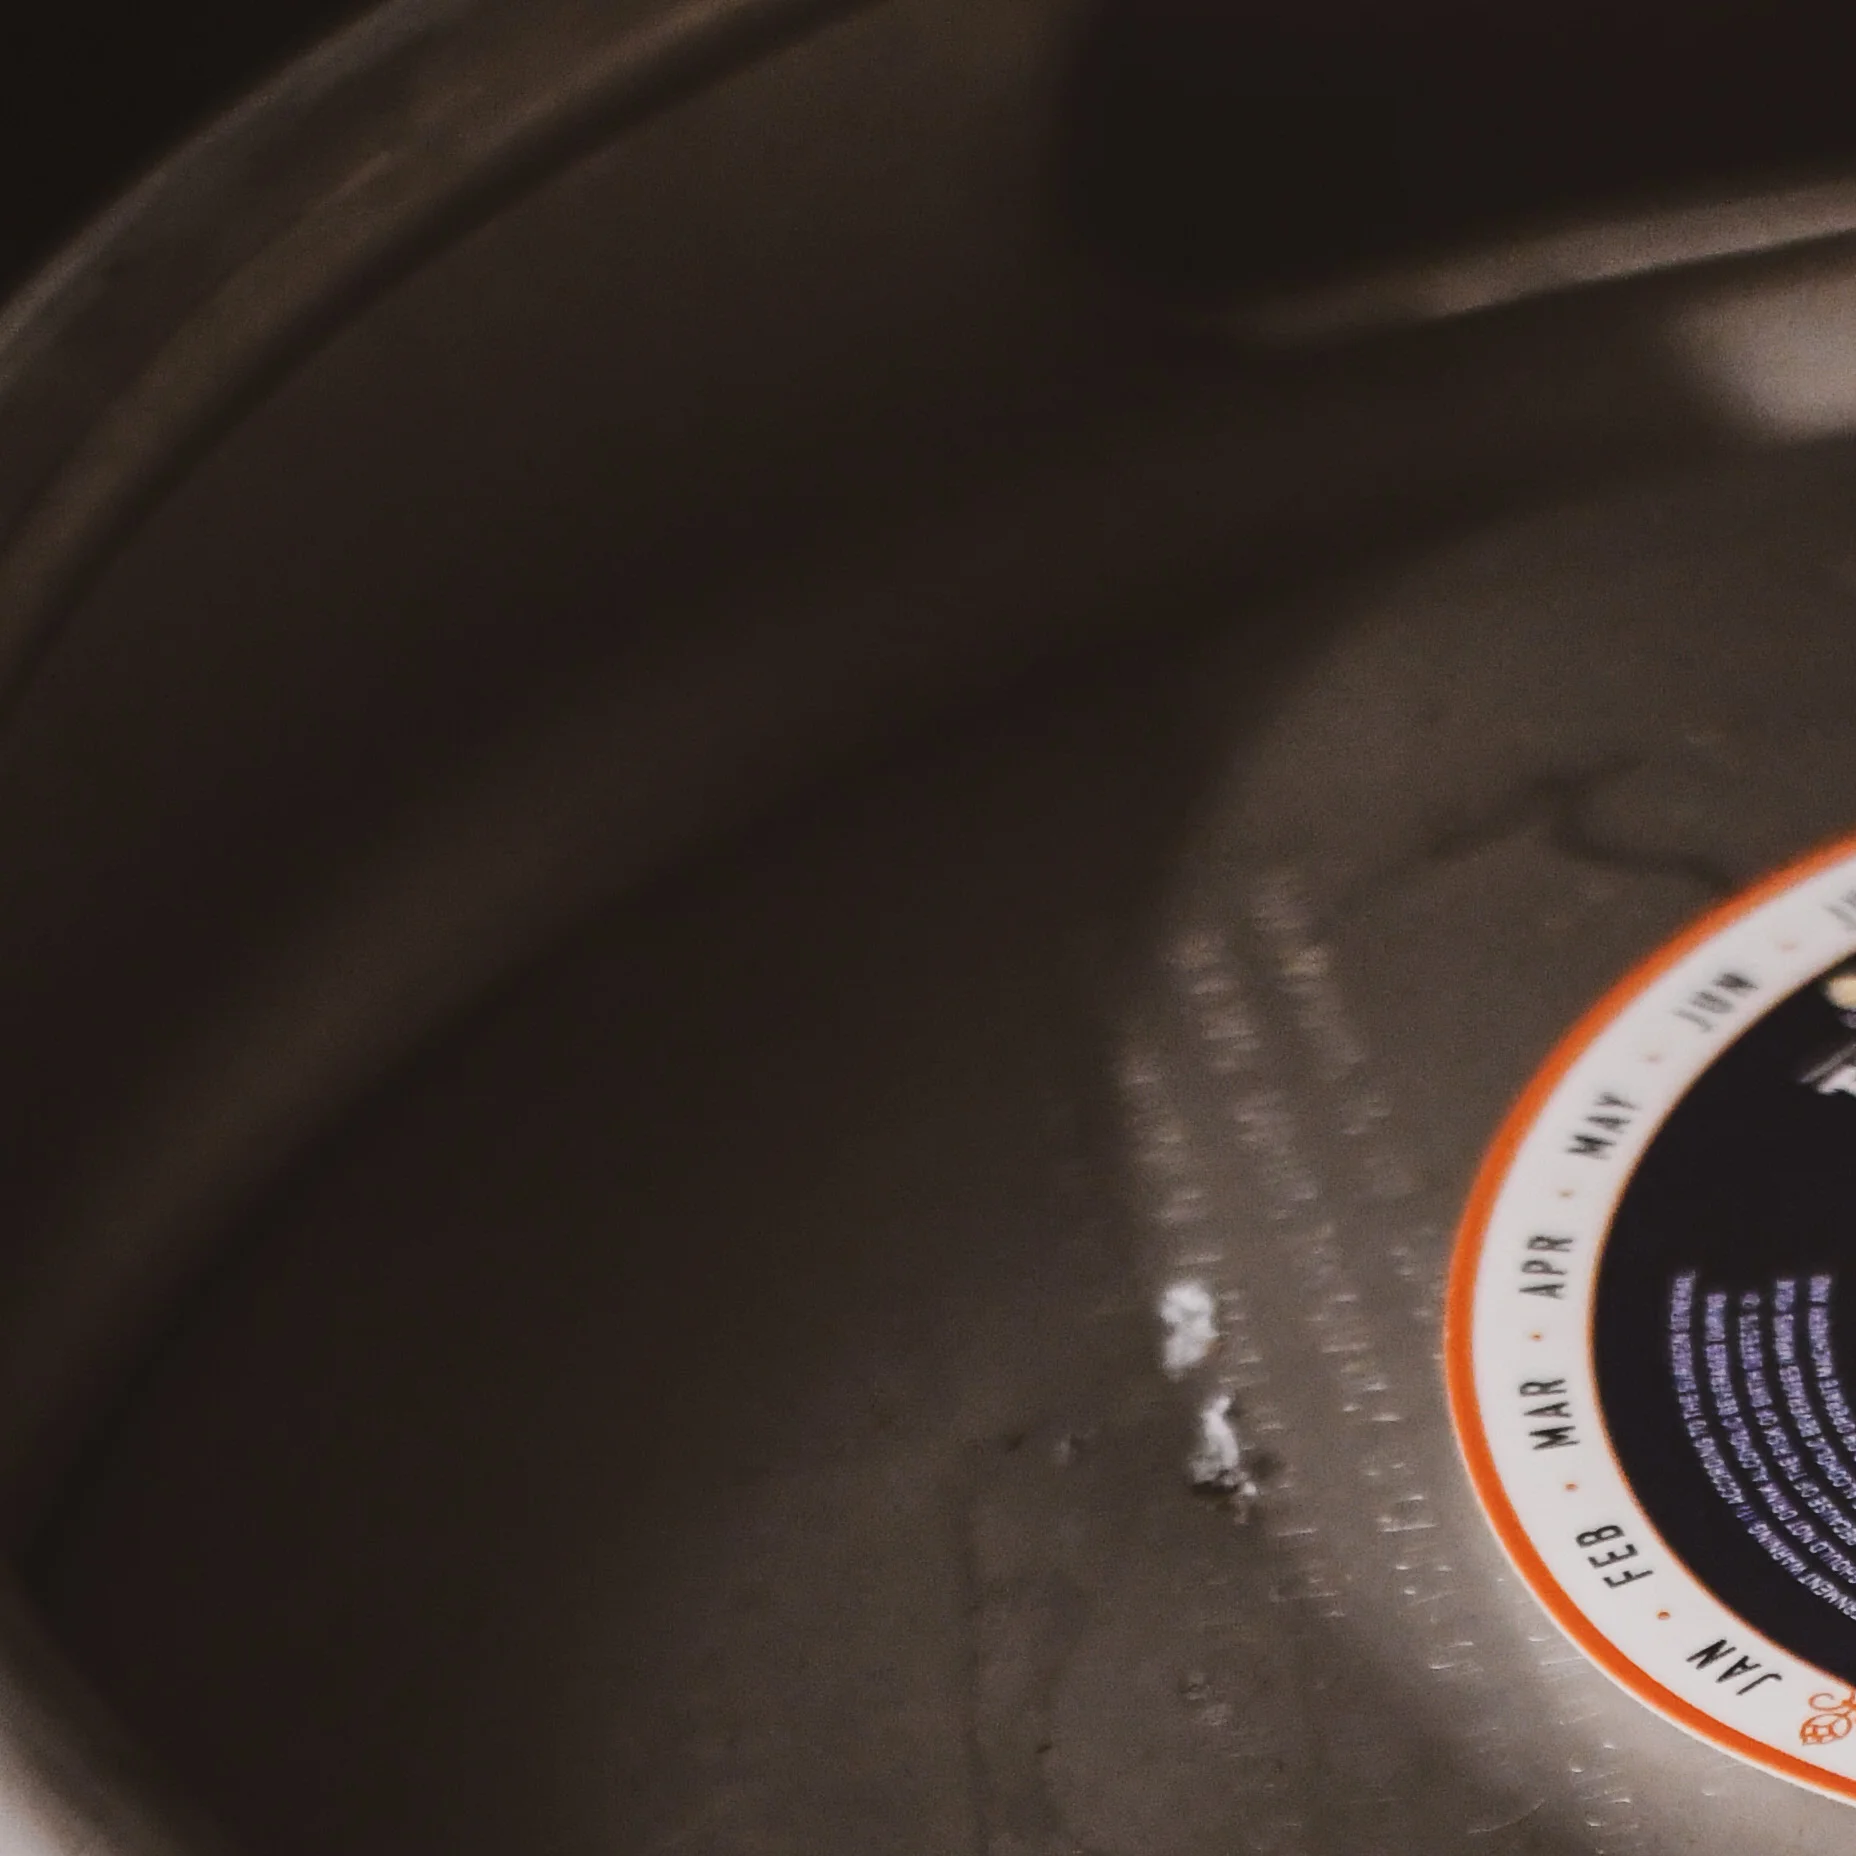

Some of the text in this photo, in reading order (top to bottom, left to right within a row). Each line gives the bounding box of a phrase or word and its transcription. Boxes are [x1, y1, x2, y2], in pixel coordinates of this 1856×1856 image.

[1674, 970, 1759, 1032] JUN
[1567, 1091, 1638, 1159] MAY
[1519, 1234, 1574, 1299] APR
[1518, 1378, 1579, 1450] MAR
[1575, 1524, 1654, 1589] FEB
[1686, 1638, 1783, 1695] JAN
